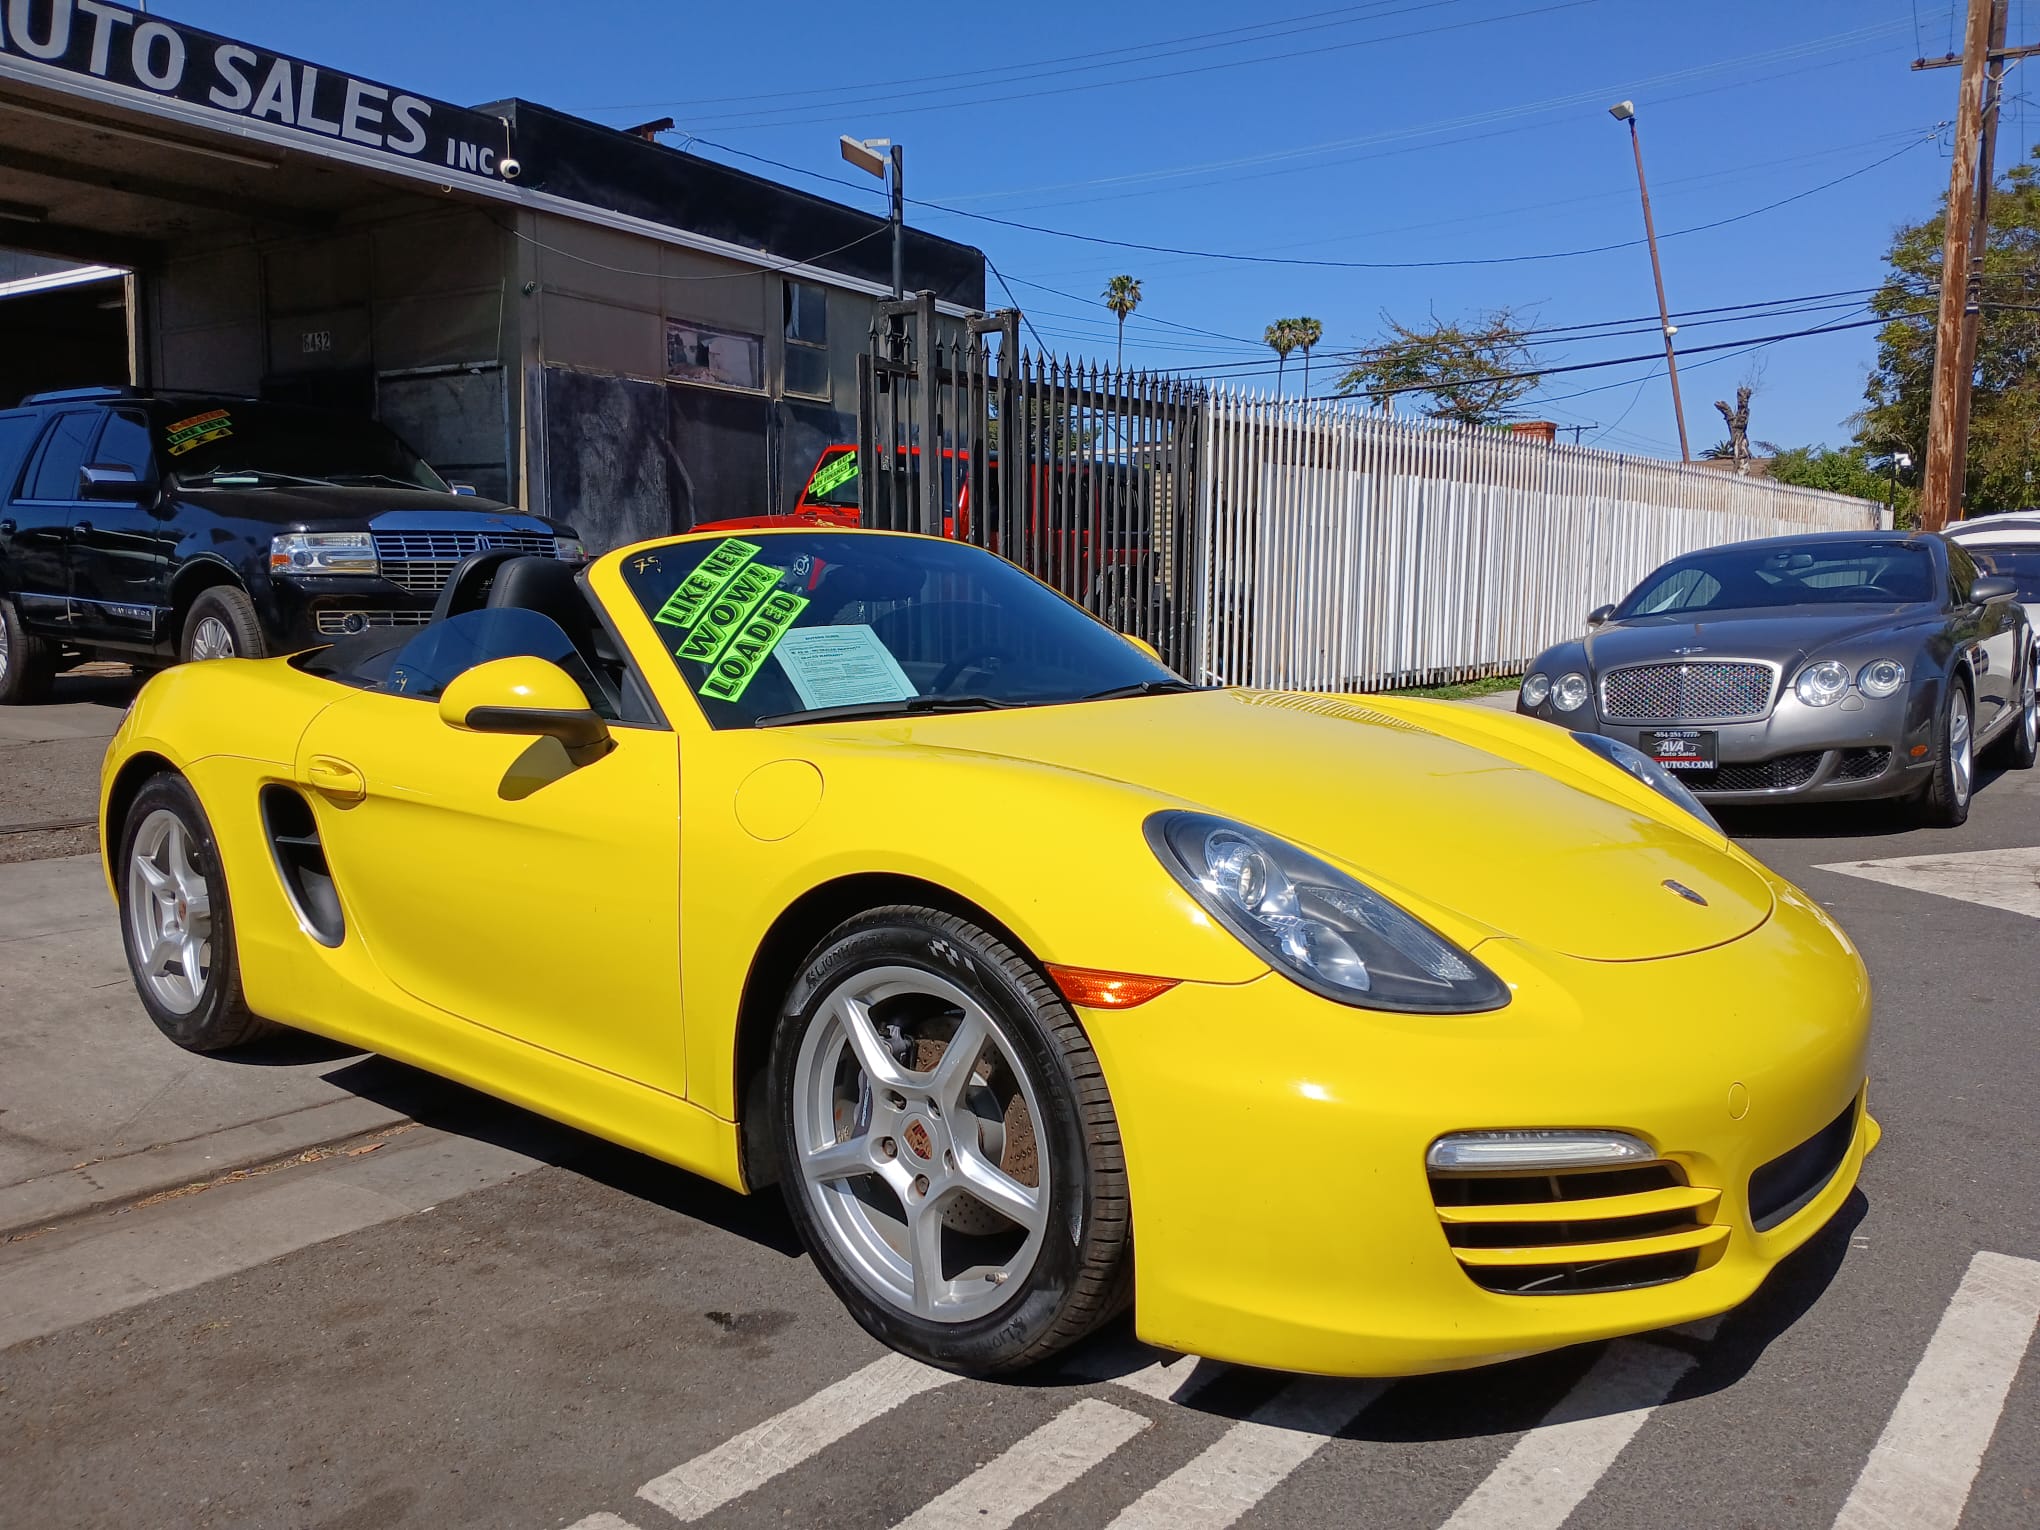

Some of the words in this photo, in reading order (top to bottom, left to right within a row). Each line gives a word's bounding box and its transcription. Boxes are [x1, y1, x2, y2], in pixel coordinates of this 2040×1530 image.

[0, 0, 186, 92] UTO
[209, 44, 432, 154] SALES
[446, 138, 494, 175] INC
[199, 418, 227, 430] NEW
[660, 574, 720, 625] LIKE
[701, 540, 755, 577] NEW
[678, 564, 777, 659] WOW!
[706, 593, 803, 698] LOADED
[1661, 740, 1684, 751] AVA
